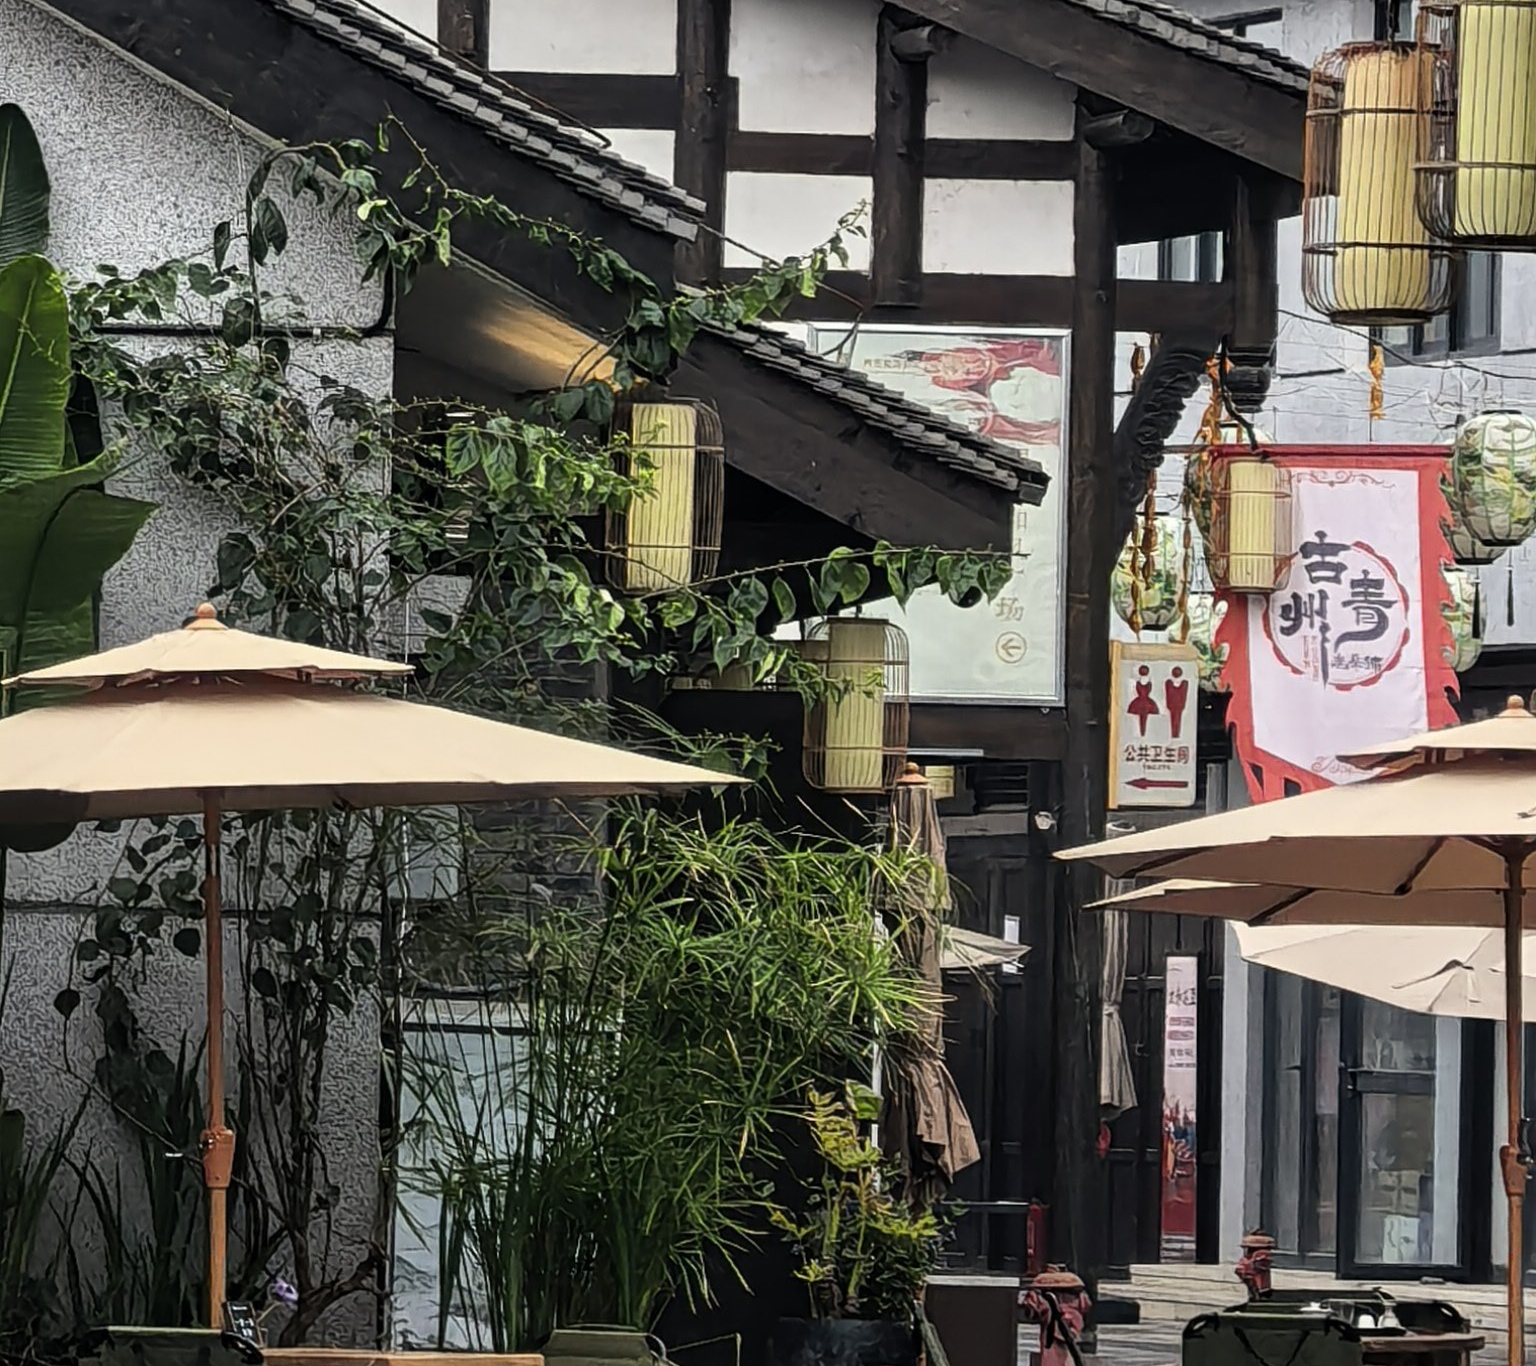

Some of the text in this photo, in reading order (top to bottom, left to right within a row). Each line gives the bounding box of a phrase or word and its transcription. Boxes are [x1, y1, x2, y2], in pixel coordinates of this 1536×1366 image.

[1124, 744, 1189, 764] 公共卫生间
